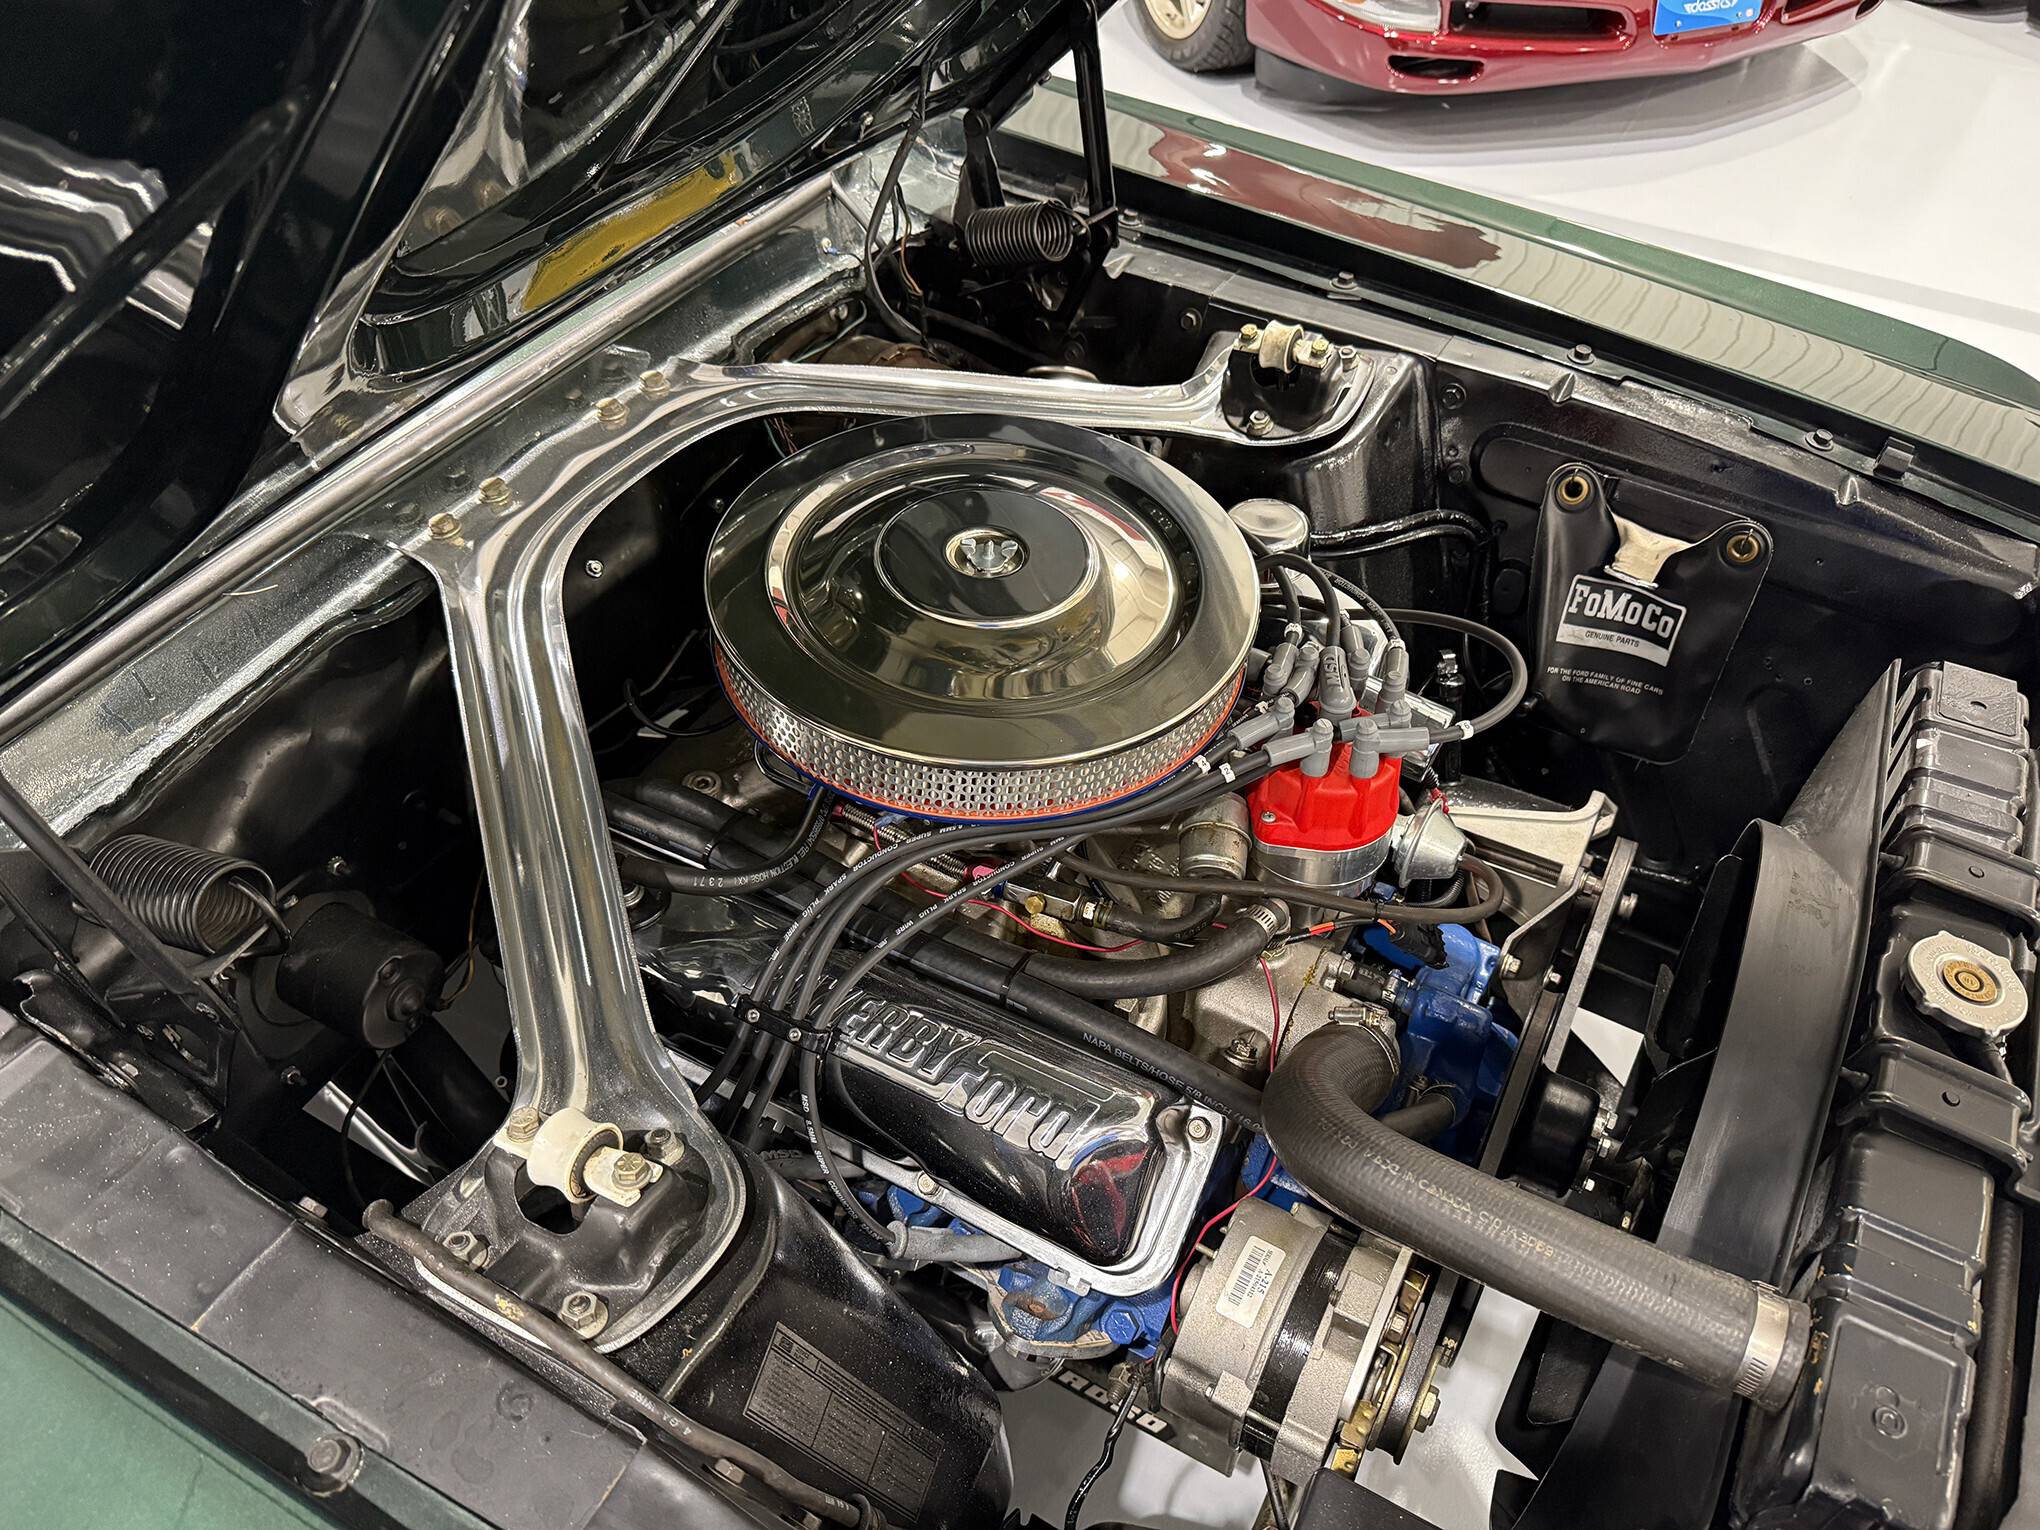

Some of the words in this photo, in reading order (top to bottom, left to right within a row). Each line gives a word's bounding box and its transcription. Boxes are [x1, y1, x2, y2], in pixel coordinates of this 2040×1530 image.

[1334, 577, 1368, 601] CONDUCTOR
[1568, 583, 1675, 638] FoMoCo
[1585, 630, 1614, 642] GENUINE
[1615, 636, 1640, 648] PARTS
[1560, 668, 1572, 676] THE
[1572, 669, 1589, 677] FORD
[1590, 671, 1614, 682] FAMILY
[1615, 676, 1626, 684] OF
[1627, 679, 1643, 688] FINE
[1643, 682, 1664, 695] CARS
[1584, 678, 1620, 690] AMERICAN
[1620, 684, 1641, 695] ROAD
[906, 831, 932, 844] SUPER
[853, 843, 899, 872] CONDUCTOR
[1021, 847, 1044, 861] SUPER
[750, 870, 770, 883] HOSE
[823, 873, 847, 895] SPARK
[972, 861, 1016, 887] CONDUCTOR
[943, 887, 967, 904] SPARK
[802, 897, 820, 918] PLUG
[918, 905, 938, 919] PLUG
[784, 921, 799, 942] WIRE
[895, 920, 914, 936] WIRE
[1082, 1032, 1112, 1053] NAPA
[1114, 1049, 1185, 1091] BELTS/HOSE
[1204, 1095, 1232, 1115] INCH
[801, 1094, 810, 1113] MSD
[939, 1049, 1118, 1170] Ford
[805, 1119, 818, 1144] 8.5MM
[814, 1149, 830, 1175] SUPER
[827, 1179, 859, 1220] CONDUCTOR
[1401, 1170, 1417, 1185] IN
[1418, 1179, 1473, 1214] CANADA
[1258, 1269, 1273, 1295] A-215
[629, 1389, 657, 1413] WIRE
[662, 1415, 681, 1428] GA
[682, 1426, 692, 1436] 4
